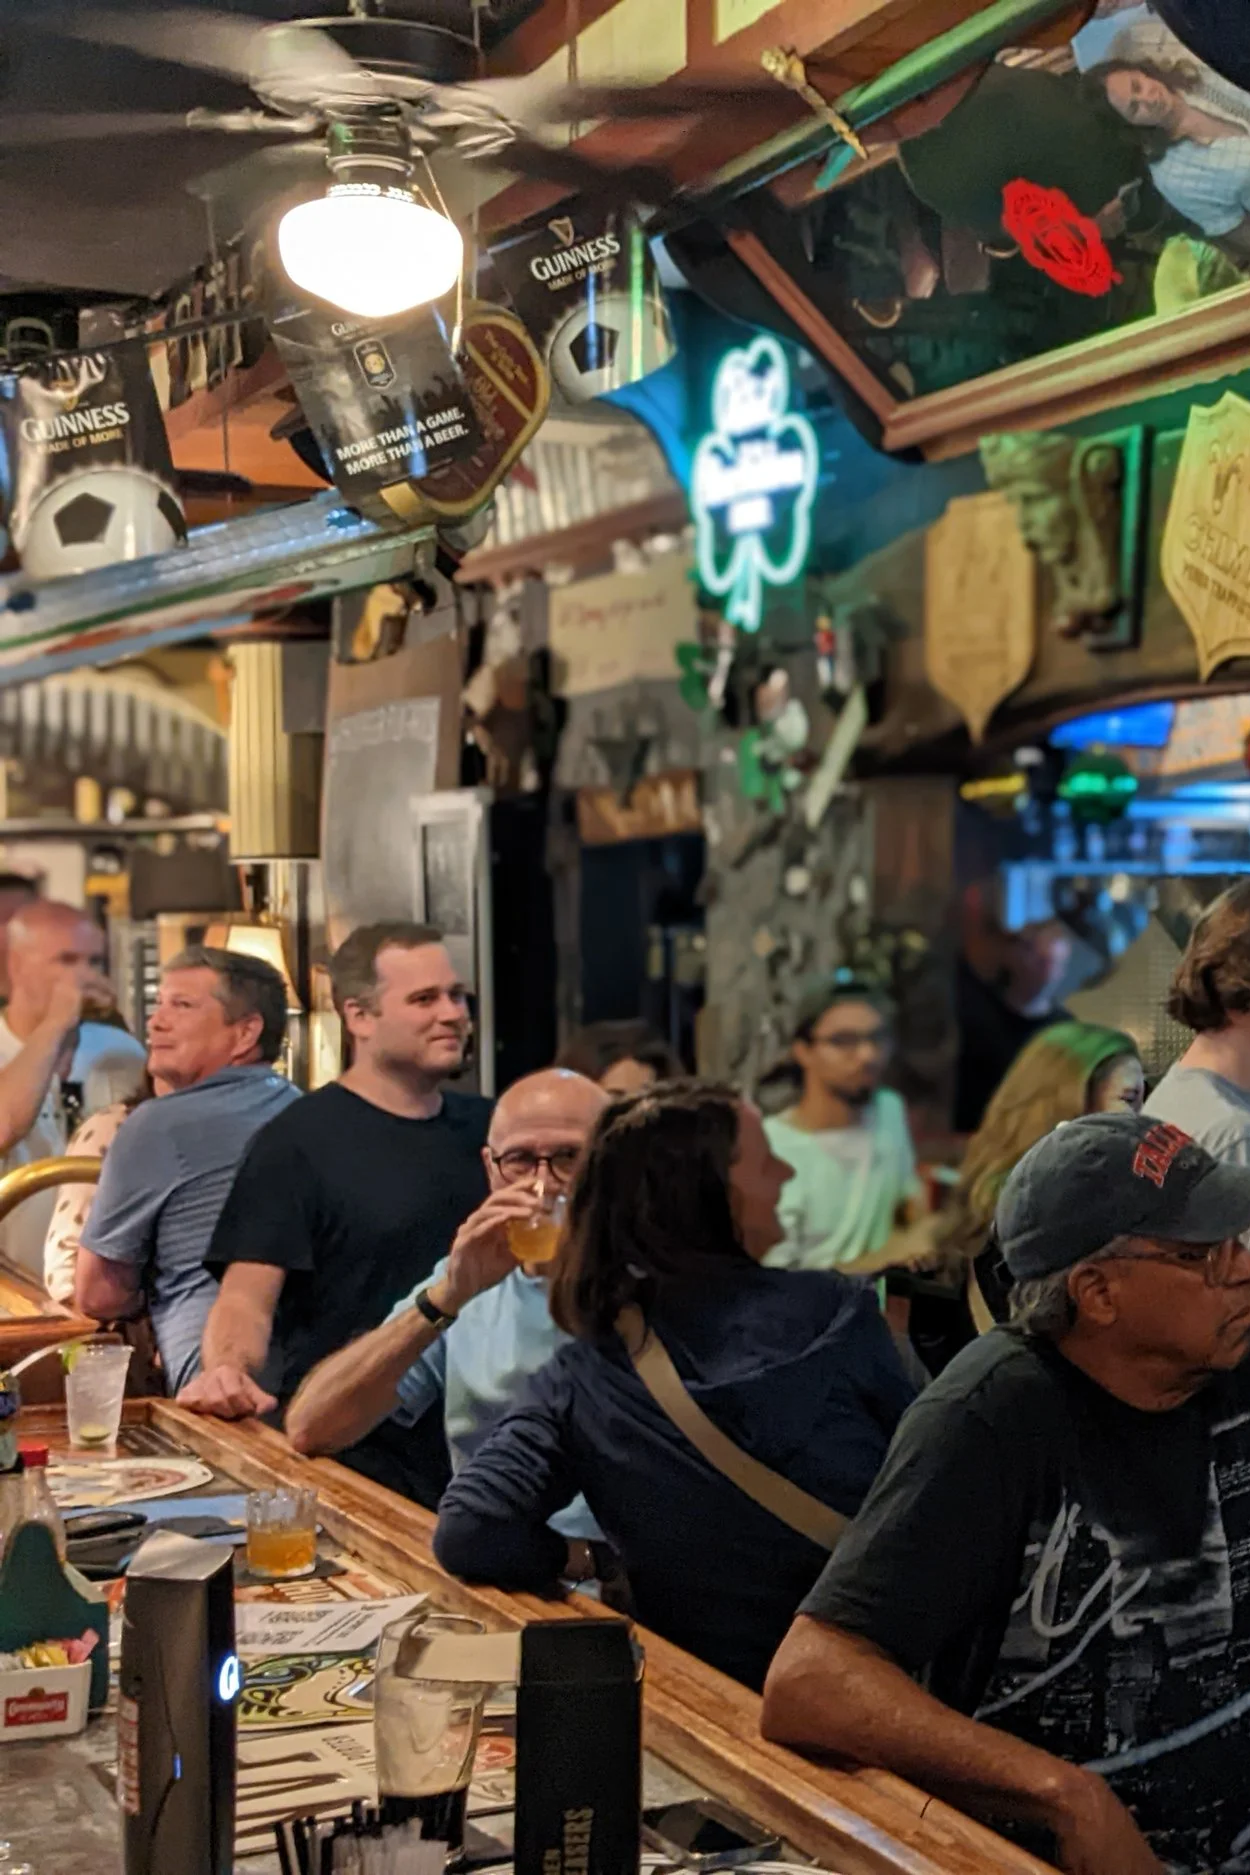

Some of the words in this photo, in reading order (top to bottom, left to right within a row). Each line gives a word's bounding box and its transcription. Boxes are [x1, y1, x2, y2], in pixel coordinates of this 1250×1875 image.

[531, 232, 620, 280] GUINNESS
[21, 402, 131, 442] GUINNESS
[336, 437, 378, 461] MORE
[377, 424, 415, 446] THAN
[416, 420, 426, 433] A
[426, 407, 465, 428] GAME.
[345, 451, 388, 476] MORE
[386, 439, 424, 462] THAN
[425, 435, 435, 449] A
[434, 424, 469, 445] BEER.
